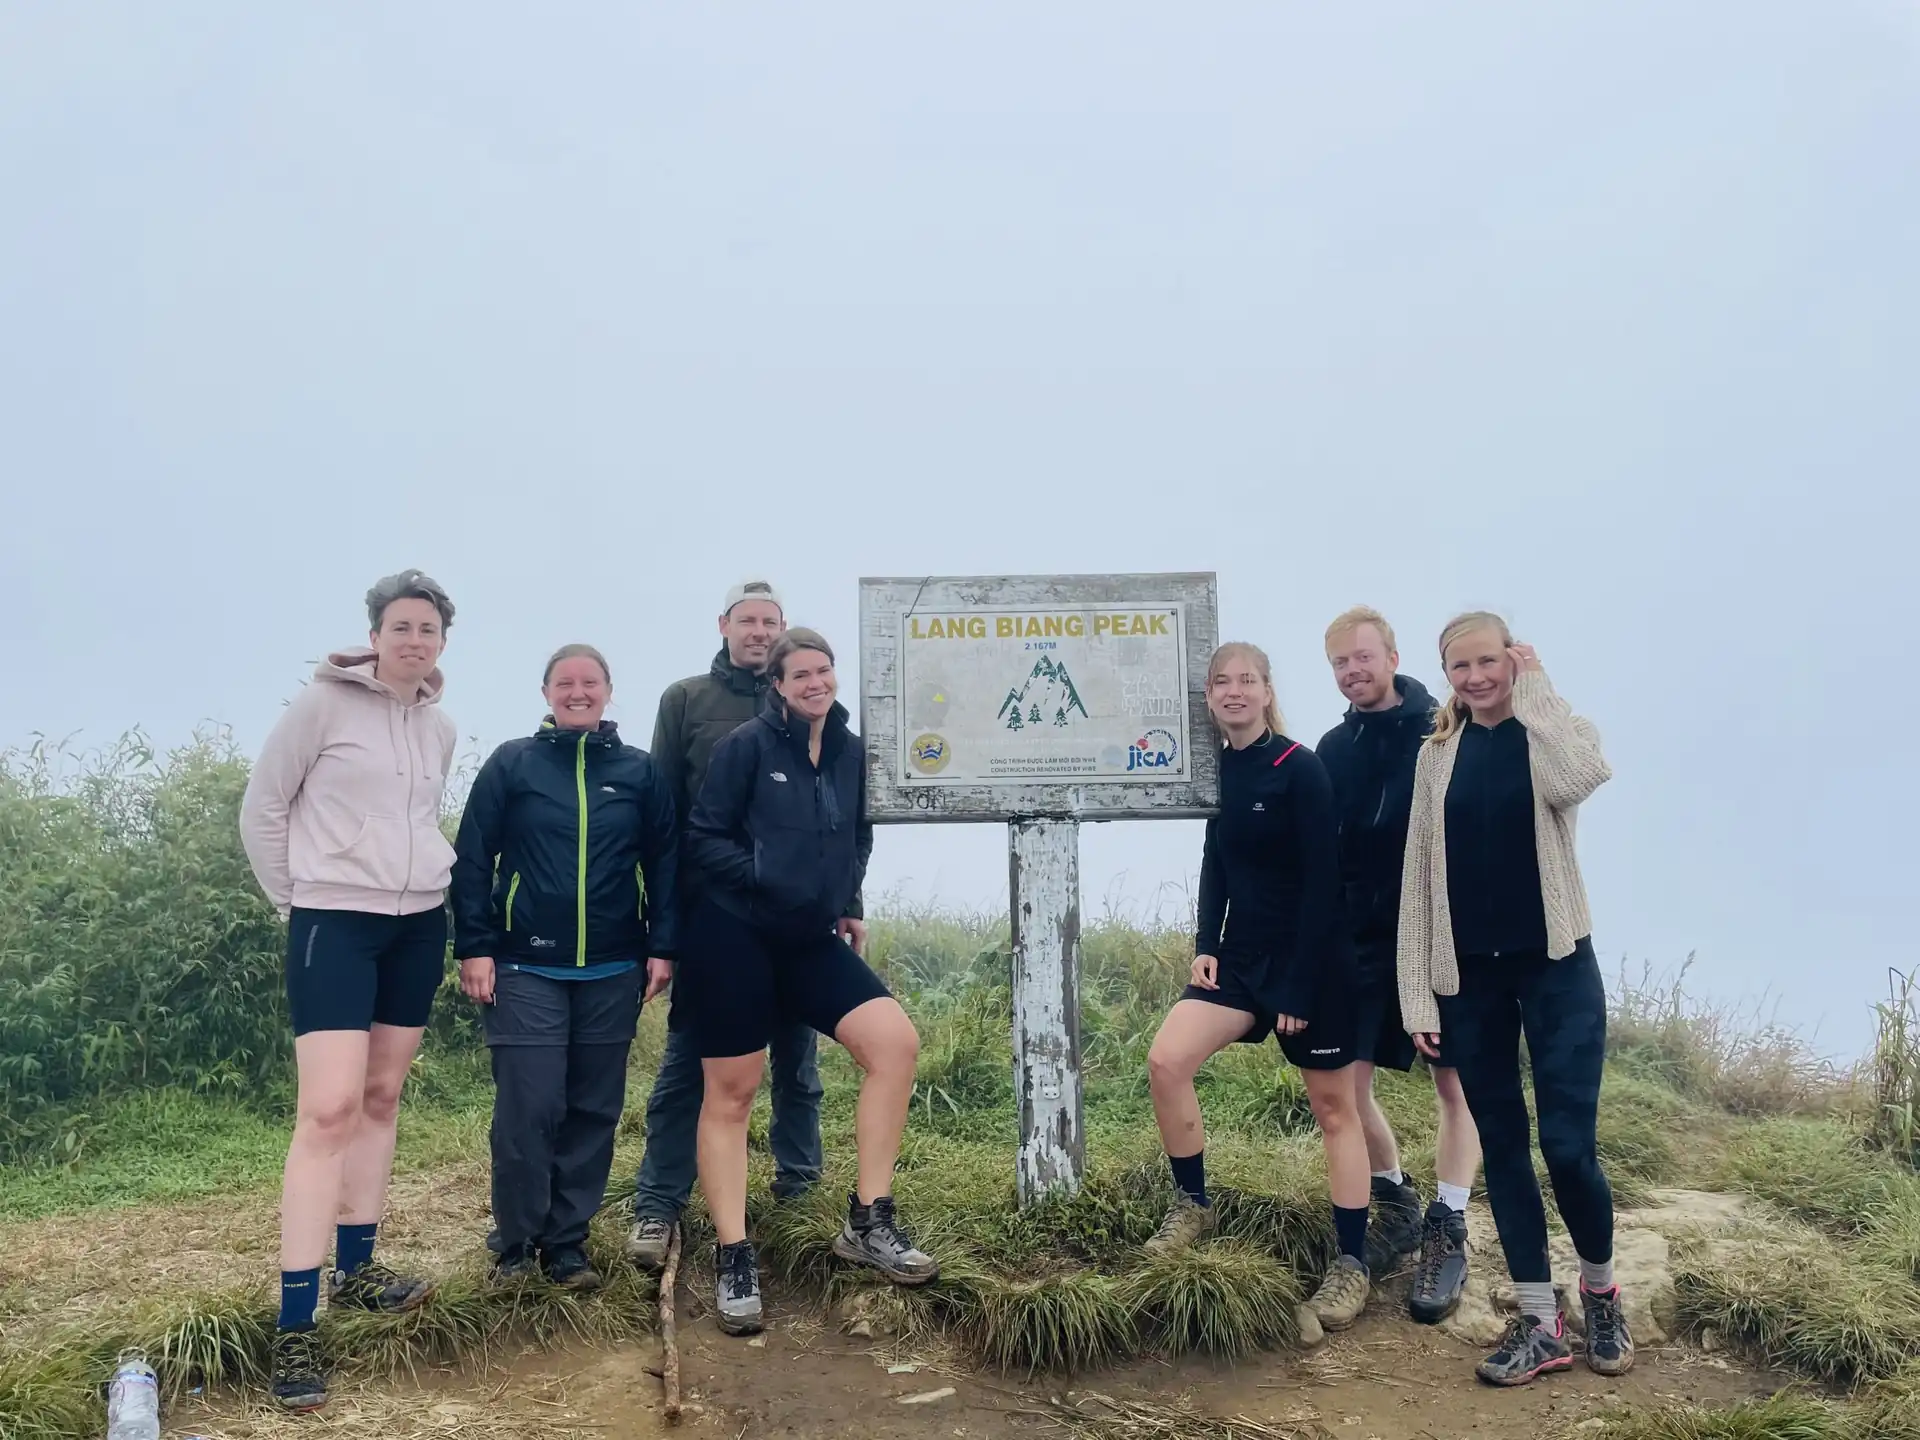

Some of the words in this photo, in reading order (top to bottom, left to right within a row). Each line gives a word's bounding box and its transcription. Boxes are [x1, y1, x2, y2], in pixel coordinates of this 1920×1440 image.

[910, 617, 986, 640] LANG
[996, 615, 1084, 638] BIANG
[1093, 613, 1169, 636] PEAK
